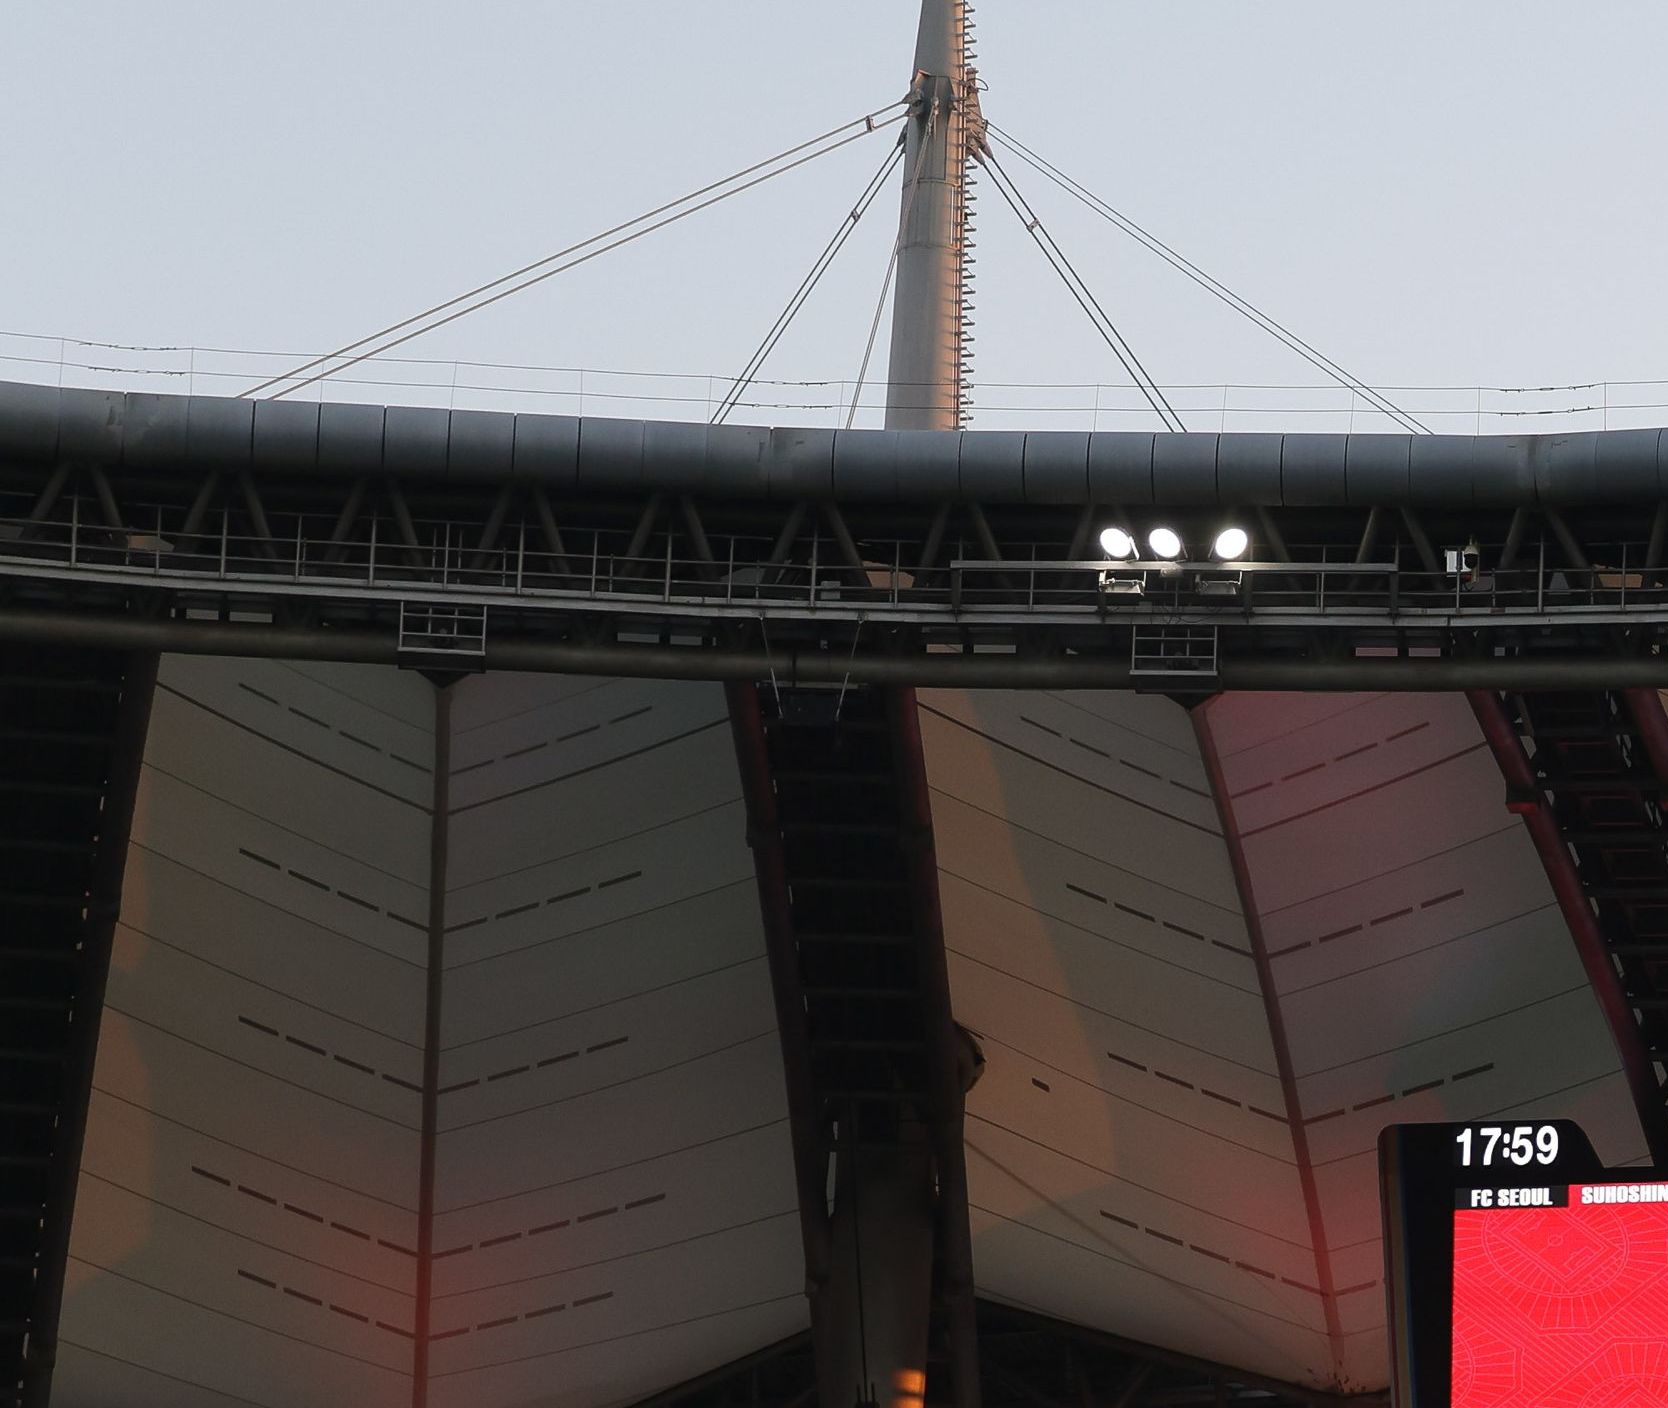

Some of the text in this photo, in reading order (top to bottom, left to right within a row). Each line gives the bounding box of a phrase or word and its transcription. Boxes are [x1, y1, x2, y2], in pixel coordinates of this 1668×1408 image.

[1457, 1126, 1559, 1166] 17:59
[1472, 1189, 1493, 1207] FC
[1498, 1188, 1553, 1206] SEOUL
